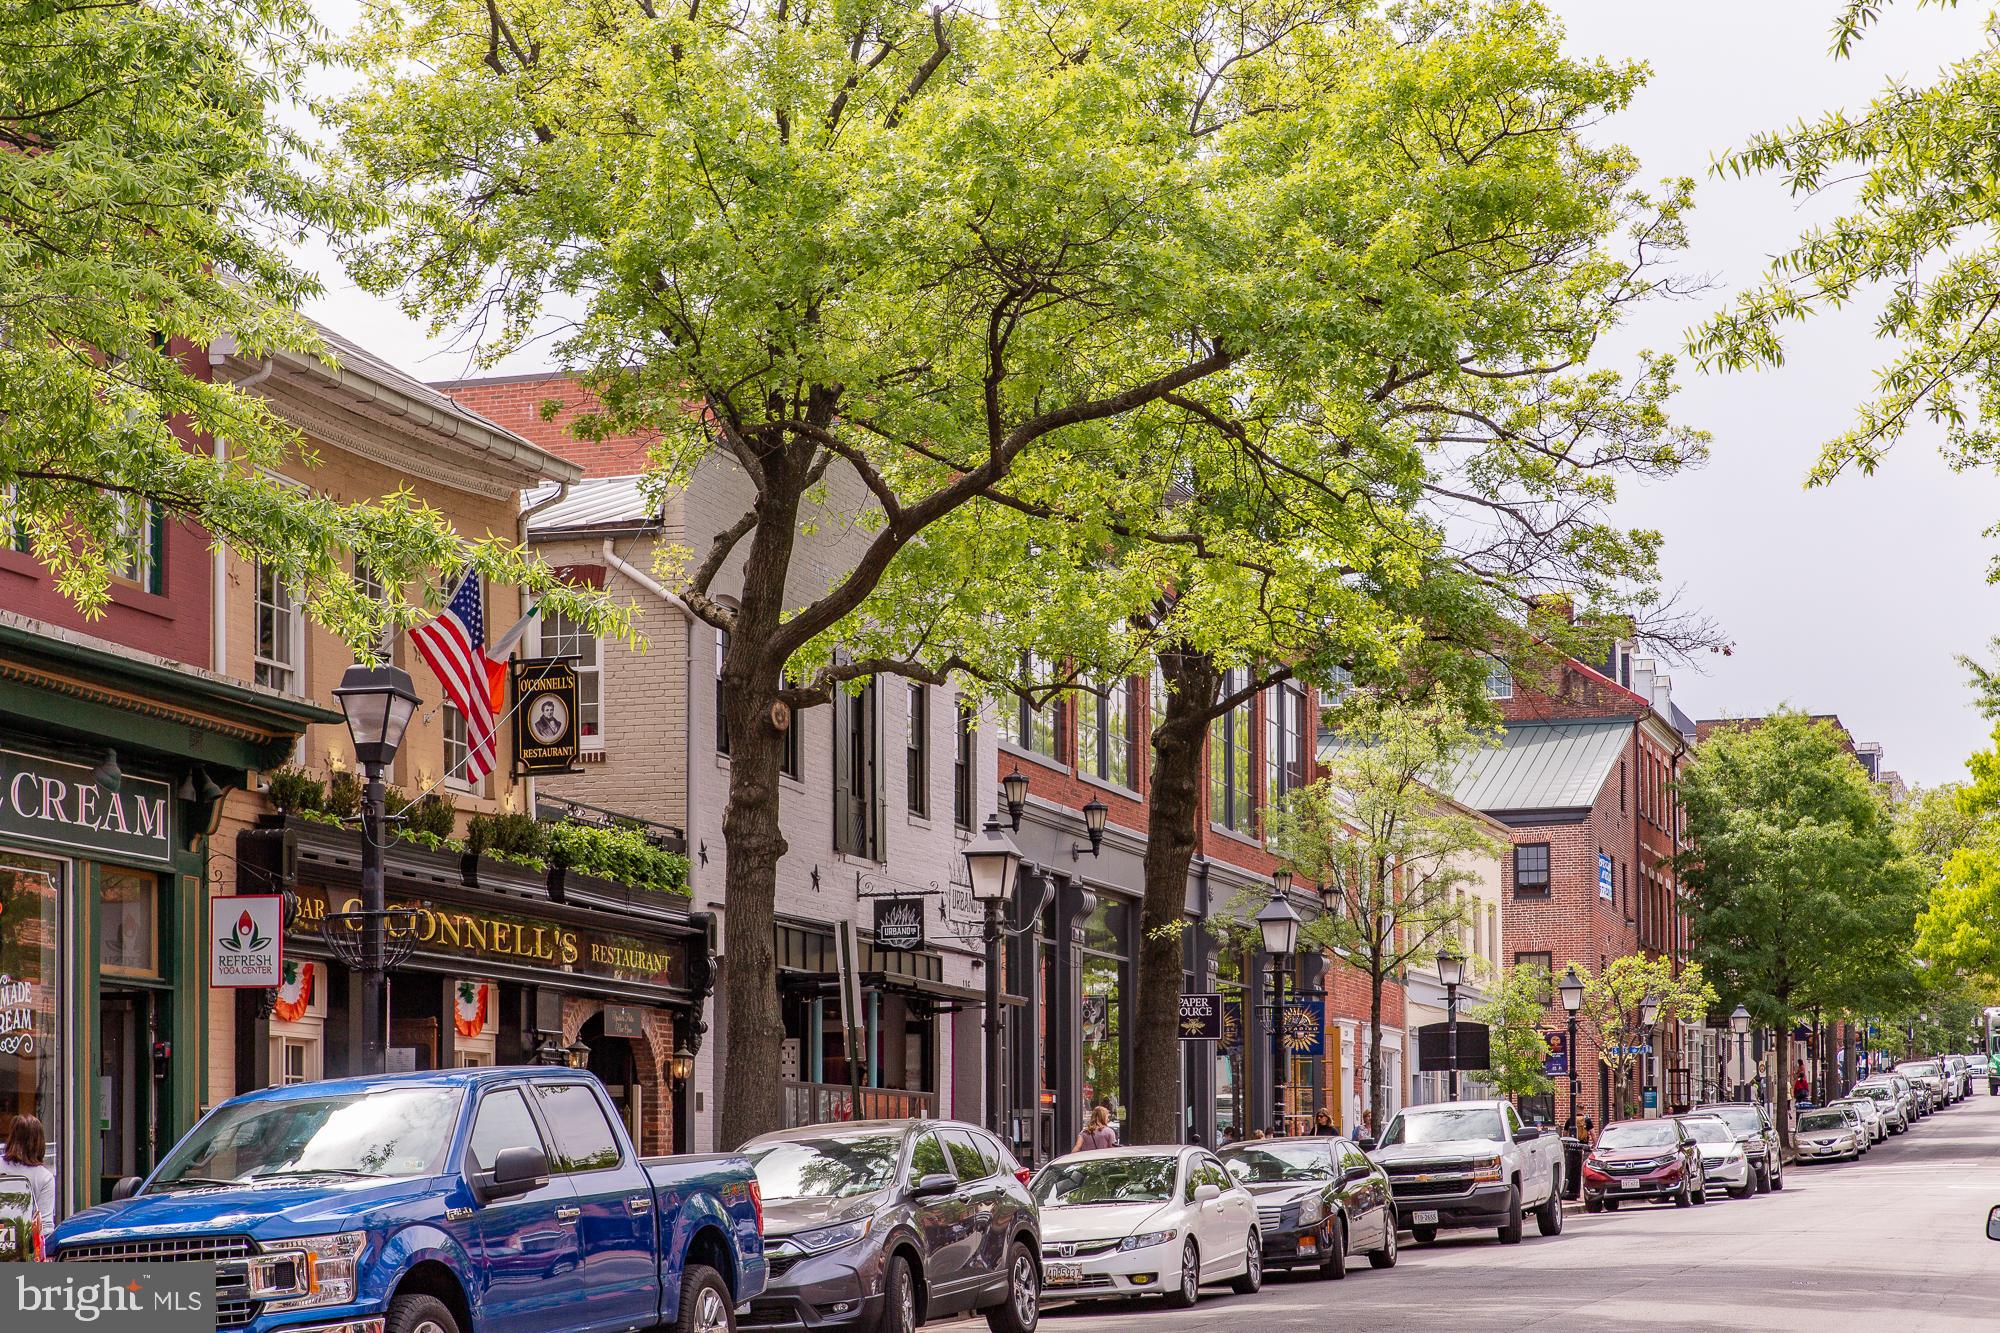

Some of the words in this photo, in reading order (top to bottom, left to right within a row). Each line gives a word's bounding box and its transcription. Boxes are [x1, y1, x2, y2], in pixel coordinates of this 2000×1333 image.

[521, 676, 574, 691] O'CONNELL'S
[523, 746, 573, 758] RESTAURANT
[11, 772, 167, 840] CREAM
[342, 898, 578, 963] OCONNELL'S
[591, 943, 671, 972] RESTAURANT
[884, 927, 911, 936] URBANO
[219, 955, 272, 966] REFRESH
[219, 966, 241, 976] YOGA
[242, 966, 273, 975] CENTER
[1180, 997, 1209, 1007] PAPER
[1180, 1007, 1213, 1017] OURCE
